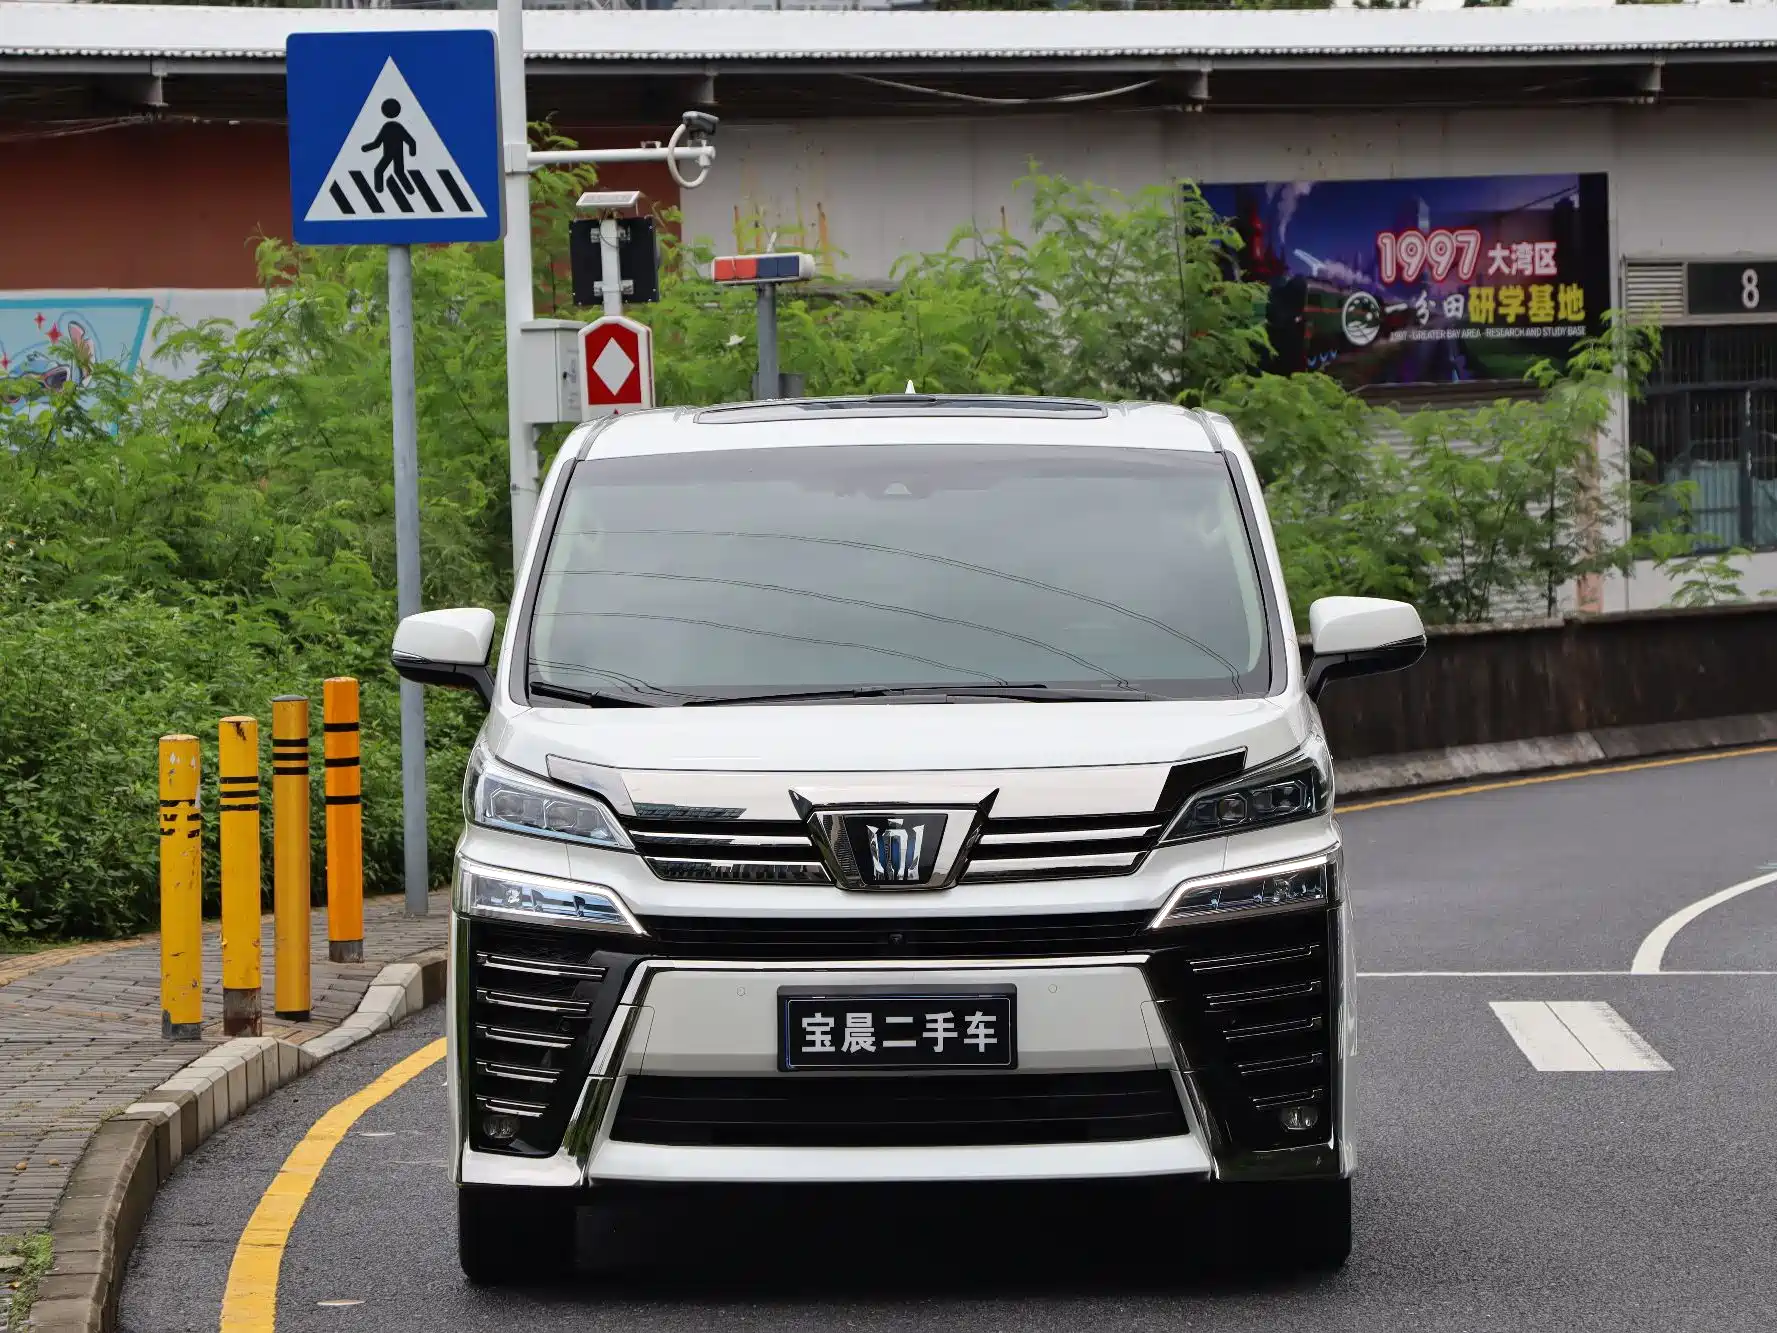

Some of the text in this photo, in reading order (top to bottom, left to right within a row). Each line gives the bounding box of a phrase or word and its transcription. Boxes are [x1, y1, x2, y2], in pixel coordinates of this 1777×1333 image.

[1378, 229, 1557, 283] 1997 大湾区
[1742, 268, 1760, 309] 8
[1462, 328, 1481, 339] AREA
[1526, 327, 1541, 337] AND
[1542, 326, 1566, 337] STUDY
[1567, 325, 1586, 336] BASE
[801, 1010, 997, 1053] 宝晨二手车
